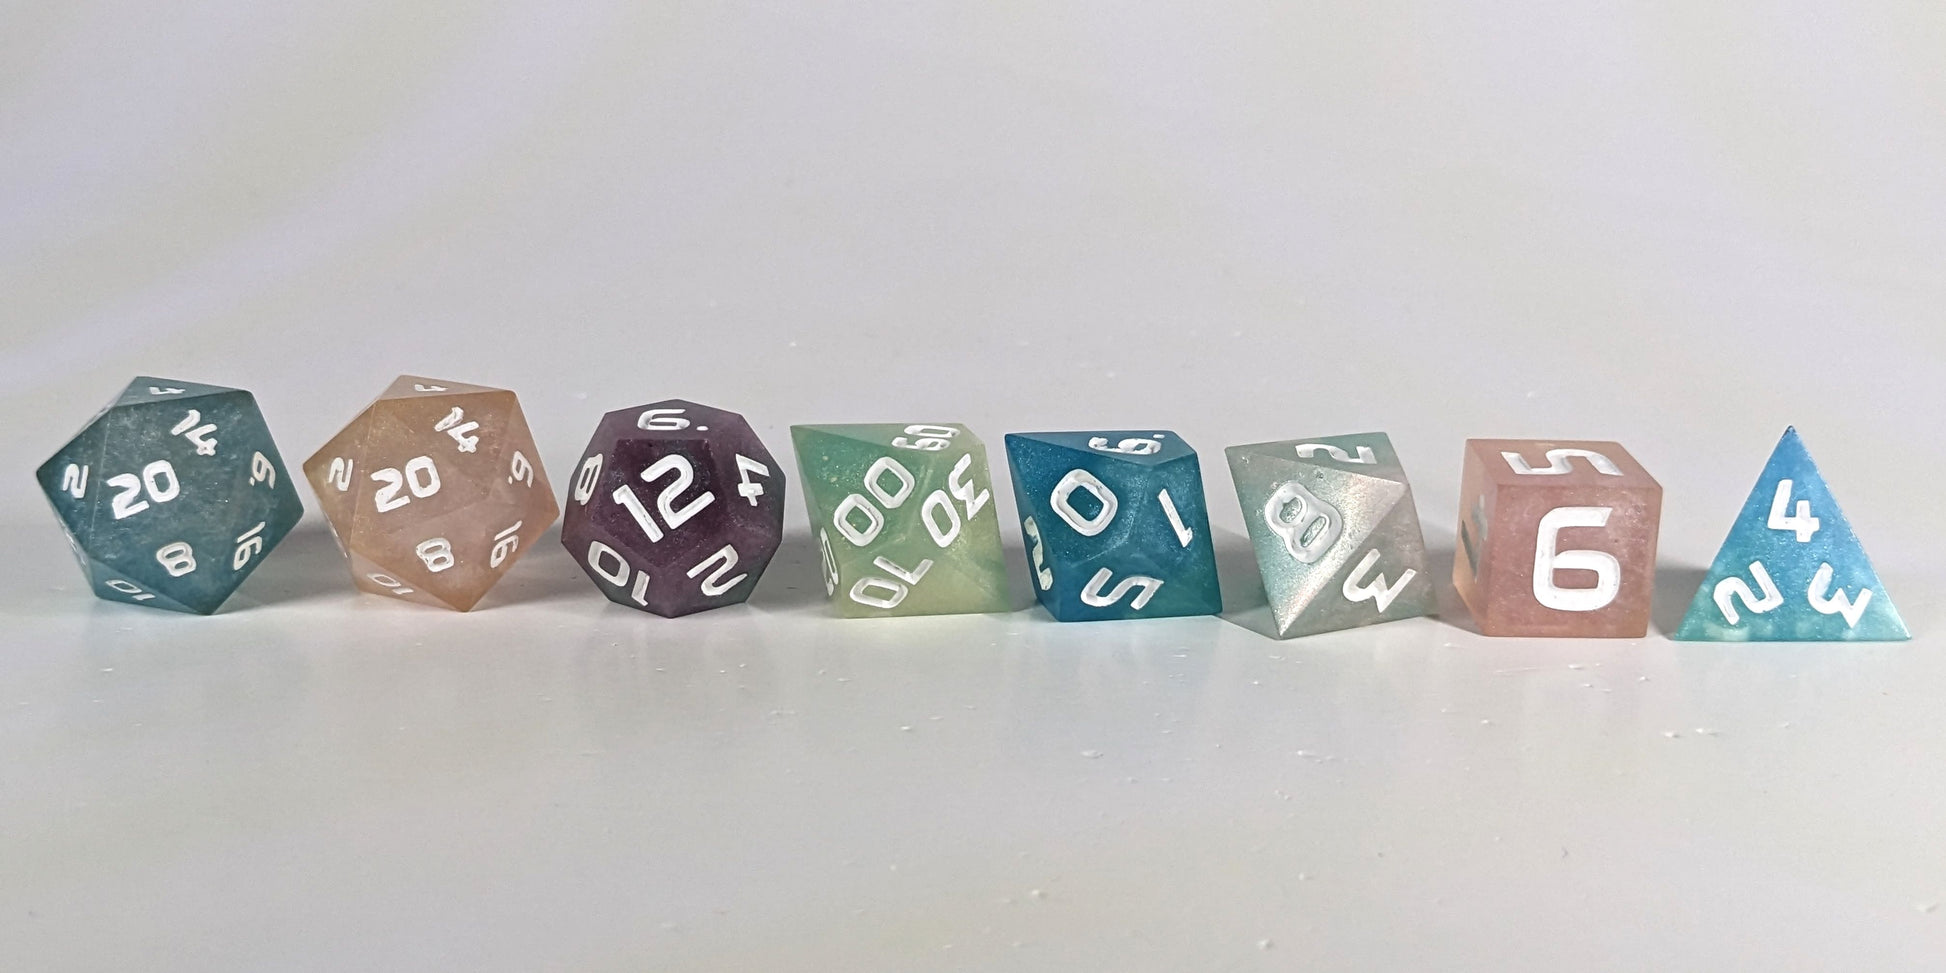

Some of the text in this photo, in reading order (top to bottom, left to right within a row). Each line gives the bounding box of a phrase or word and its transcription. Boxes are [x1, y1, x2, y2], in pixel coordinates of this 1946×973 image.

[170, 409, 218, 456] 14
[434, 406, 480, 454] 14
[1295, 443, 1377, 465] 2
[62, 463, 89, 499] 2
[106, 459, 181, 520] 20
[328, 456, 354, 492] 2
[370, 455, 441, 513] 20
[574, 453, 604, 506] 8
[735, 453, 770, 507] 4
[1500, 448, 1625, 477] 5
[612, 454, 716, 543] 12
[833, 456, 916, 547] 00
[921, 453, 990, 548] 30
[1050, 468, 1119, 537] 0
[1157, 488, 1194, 548] 1
[1264, 479, 1344, 565] 8
[1767, 478, 1820, 543] 4
[156, 541, 196, 577] 8
[233, 521, 266, 571] 16
[415, 537, 455, 573] 8
[490, 520, 523, 569] 16
[686, 544, 748, 596] 2
[1532, 506, 1621, 612] 6
[105, 579, 156, 601] 10
[367, 573, 414, 595] 10
[587, 540, 651, 607] 10
[849, 555, 934, 609] 70
[1080, 567, 1165, 611] 5
[1342, 548, 1417, 614] 3
[1713, 560, 1785, 626] 2
[1807, 561, 1873, 629] 3
